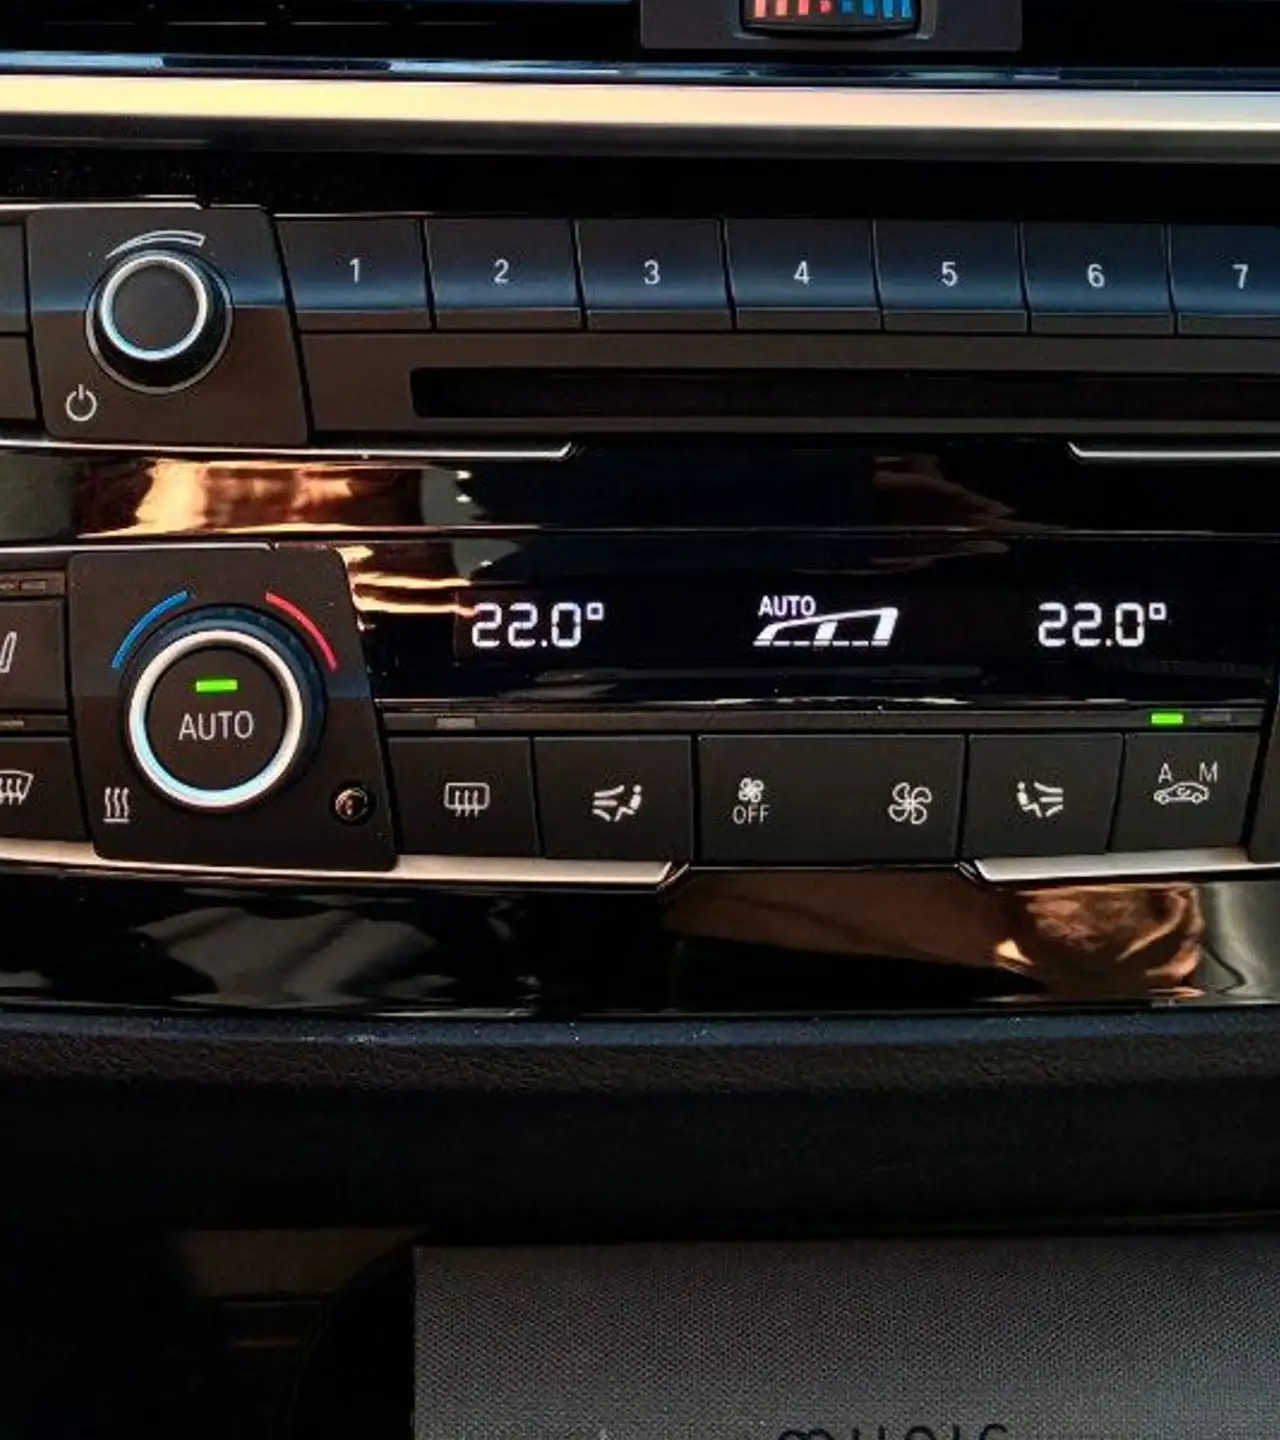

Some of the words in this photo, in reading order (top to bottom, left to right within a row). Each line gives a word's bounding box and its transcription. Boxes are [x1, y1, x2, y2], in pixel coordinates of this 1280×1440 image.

[348, 258, 361, 284] 1
[493, 259, 510, 285] 2
[643, 259, 661, 286] 3
[793, 260, 811, 286] 4
[940, 260, 959, 287] 5
[1086, 263, 1106, 290] 6
[1232, 264, 1250, 290] 7
[757, 595, 817, 618] AUTO
[177, 710, 255, 742] AUTO
[1157, 763, 1173, 784] A
[1200, 763, 1220, 784] M
[732, 803, 769, 826] OFF
